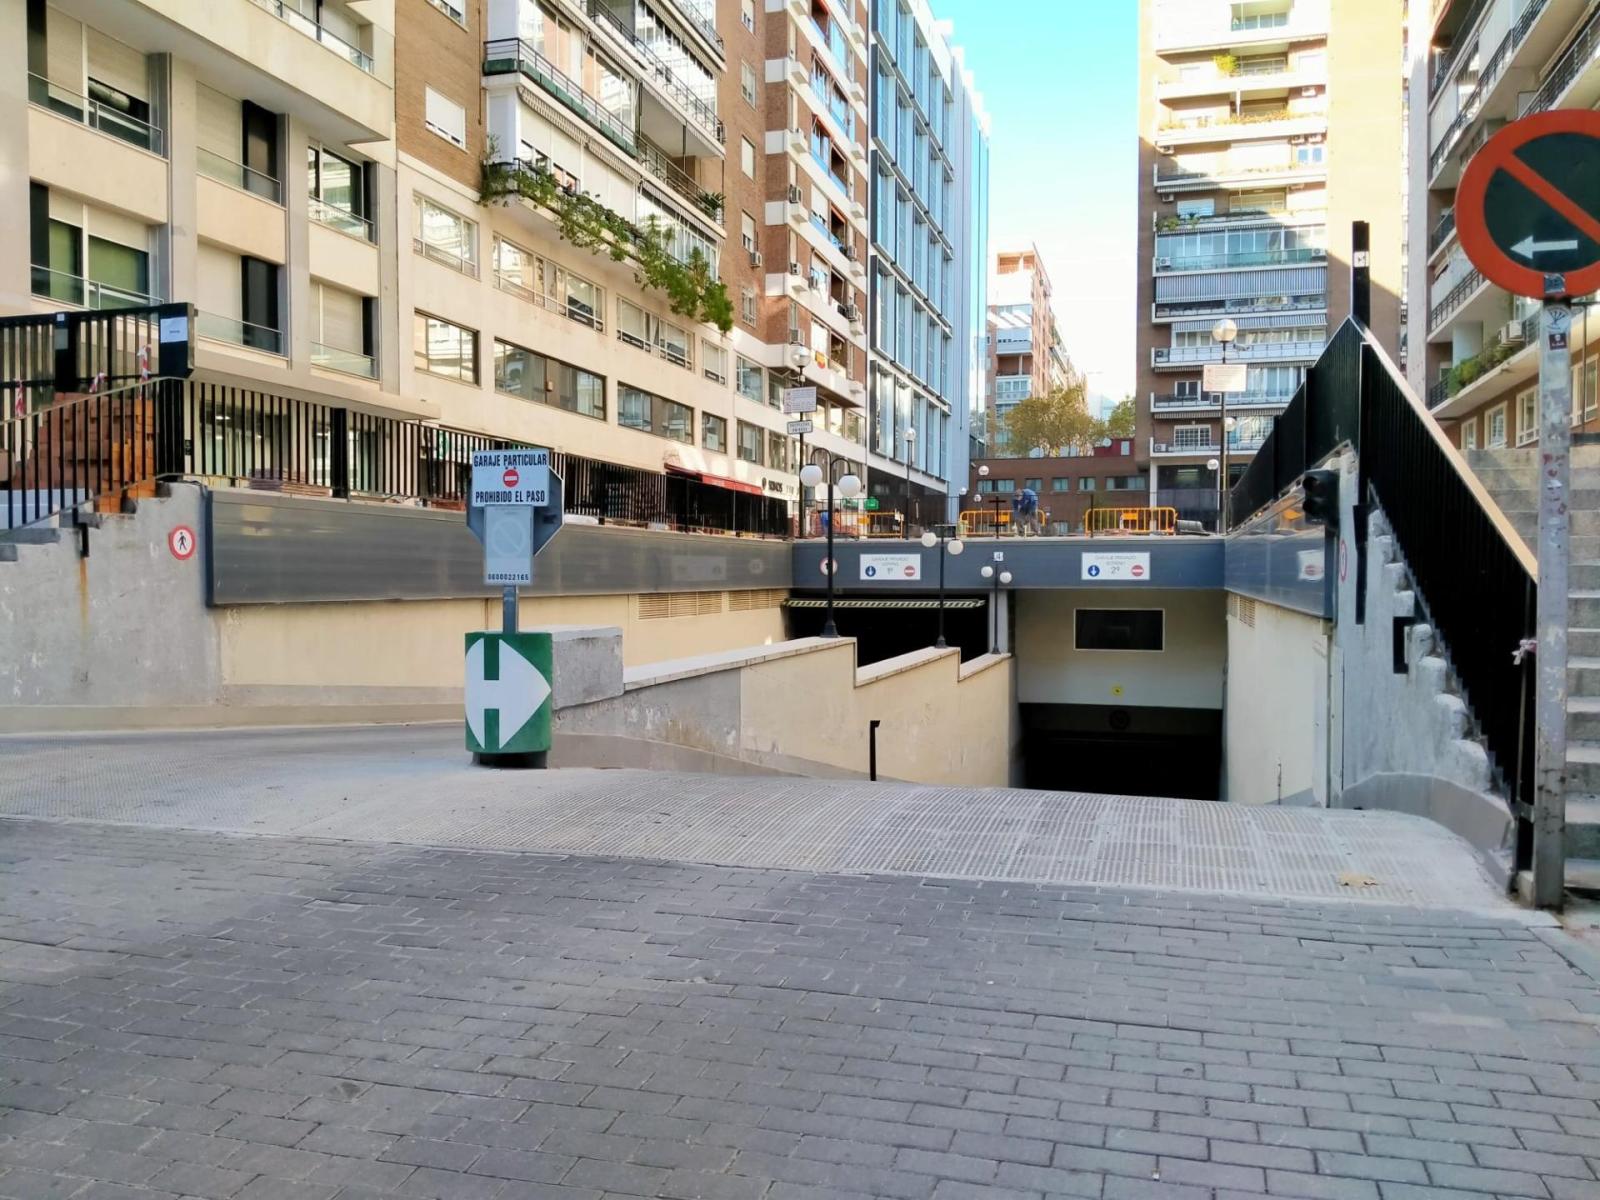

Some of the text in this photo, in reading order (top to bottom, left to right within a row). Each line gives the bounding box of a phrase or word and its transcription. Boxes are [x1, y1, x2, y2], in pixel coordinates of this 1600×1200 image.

[474, 453, 547, 467] GARAJE PARTICULAR
[475, 490, 545, 503] PROHIBIDO EL PASO
